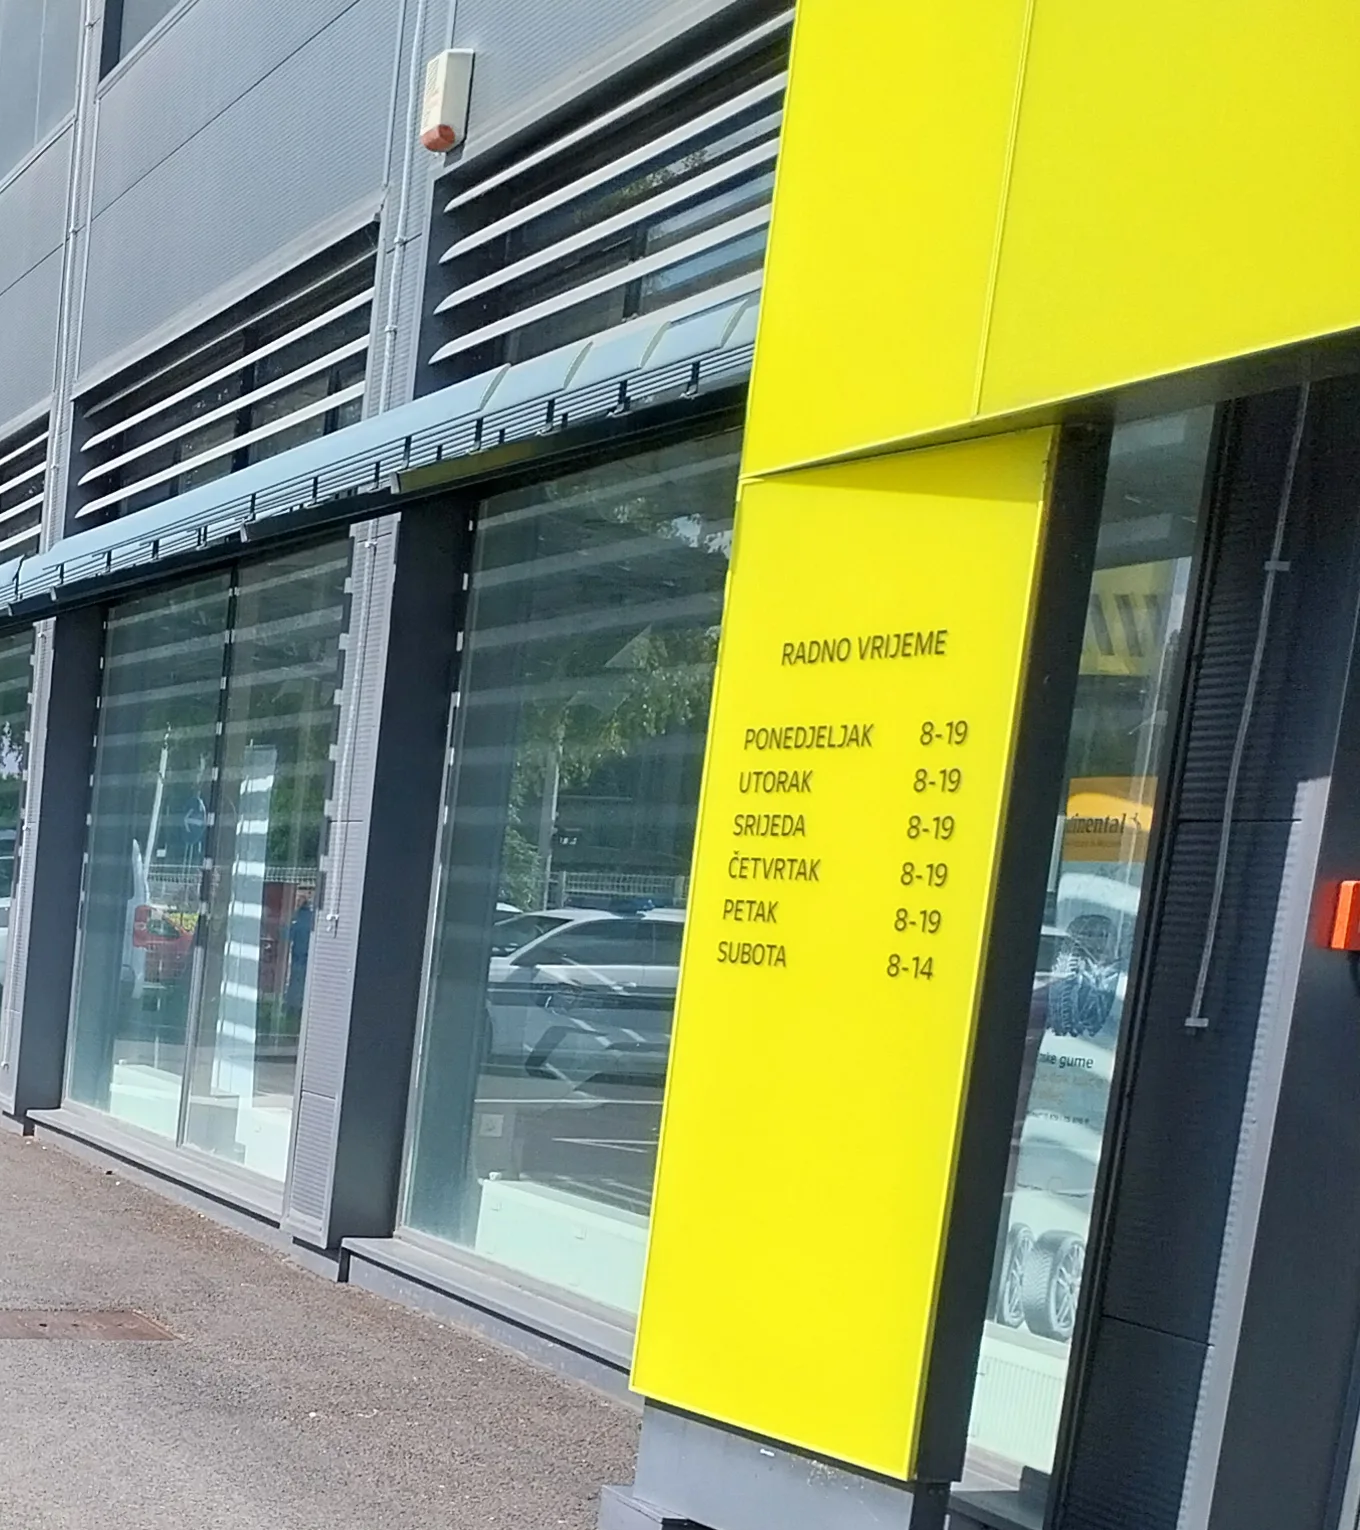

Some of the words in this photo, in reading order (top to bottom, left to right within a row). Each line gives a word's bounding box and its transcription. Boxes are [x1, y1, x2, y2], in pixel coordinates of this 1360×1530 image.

[781, 637, 851, 666] RADNO
[857, 629, 949, 660] VRIJEME
[743, 723, 874, 750] PONEDJELJAK
[919, 720, 968, 746] 8-19
[738, 770, 813, 794] UTORAK
[913, 768, 962, 793] 8-19
[733, 814, 806, 837] SRIJEDA
[906, 815, 955, 840] 8-19
[728, 851, 821, 882] ČETVRTAK
[900, 862, 948, 887] 8-19
[722, 898, 779, 924] PETAK
[894, 908, 941, 933] 8-19
[717, 941, 787, 968] SUBOTA
[886, 954, 933, 980] 8-14
[1059, 1056, 1094, 1069] gume
